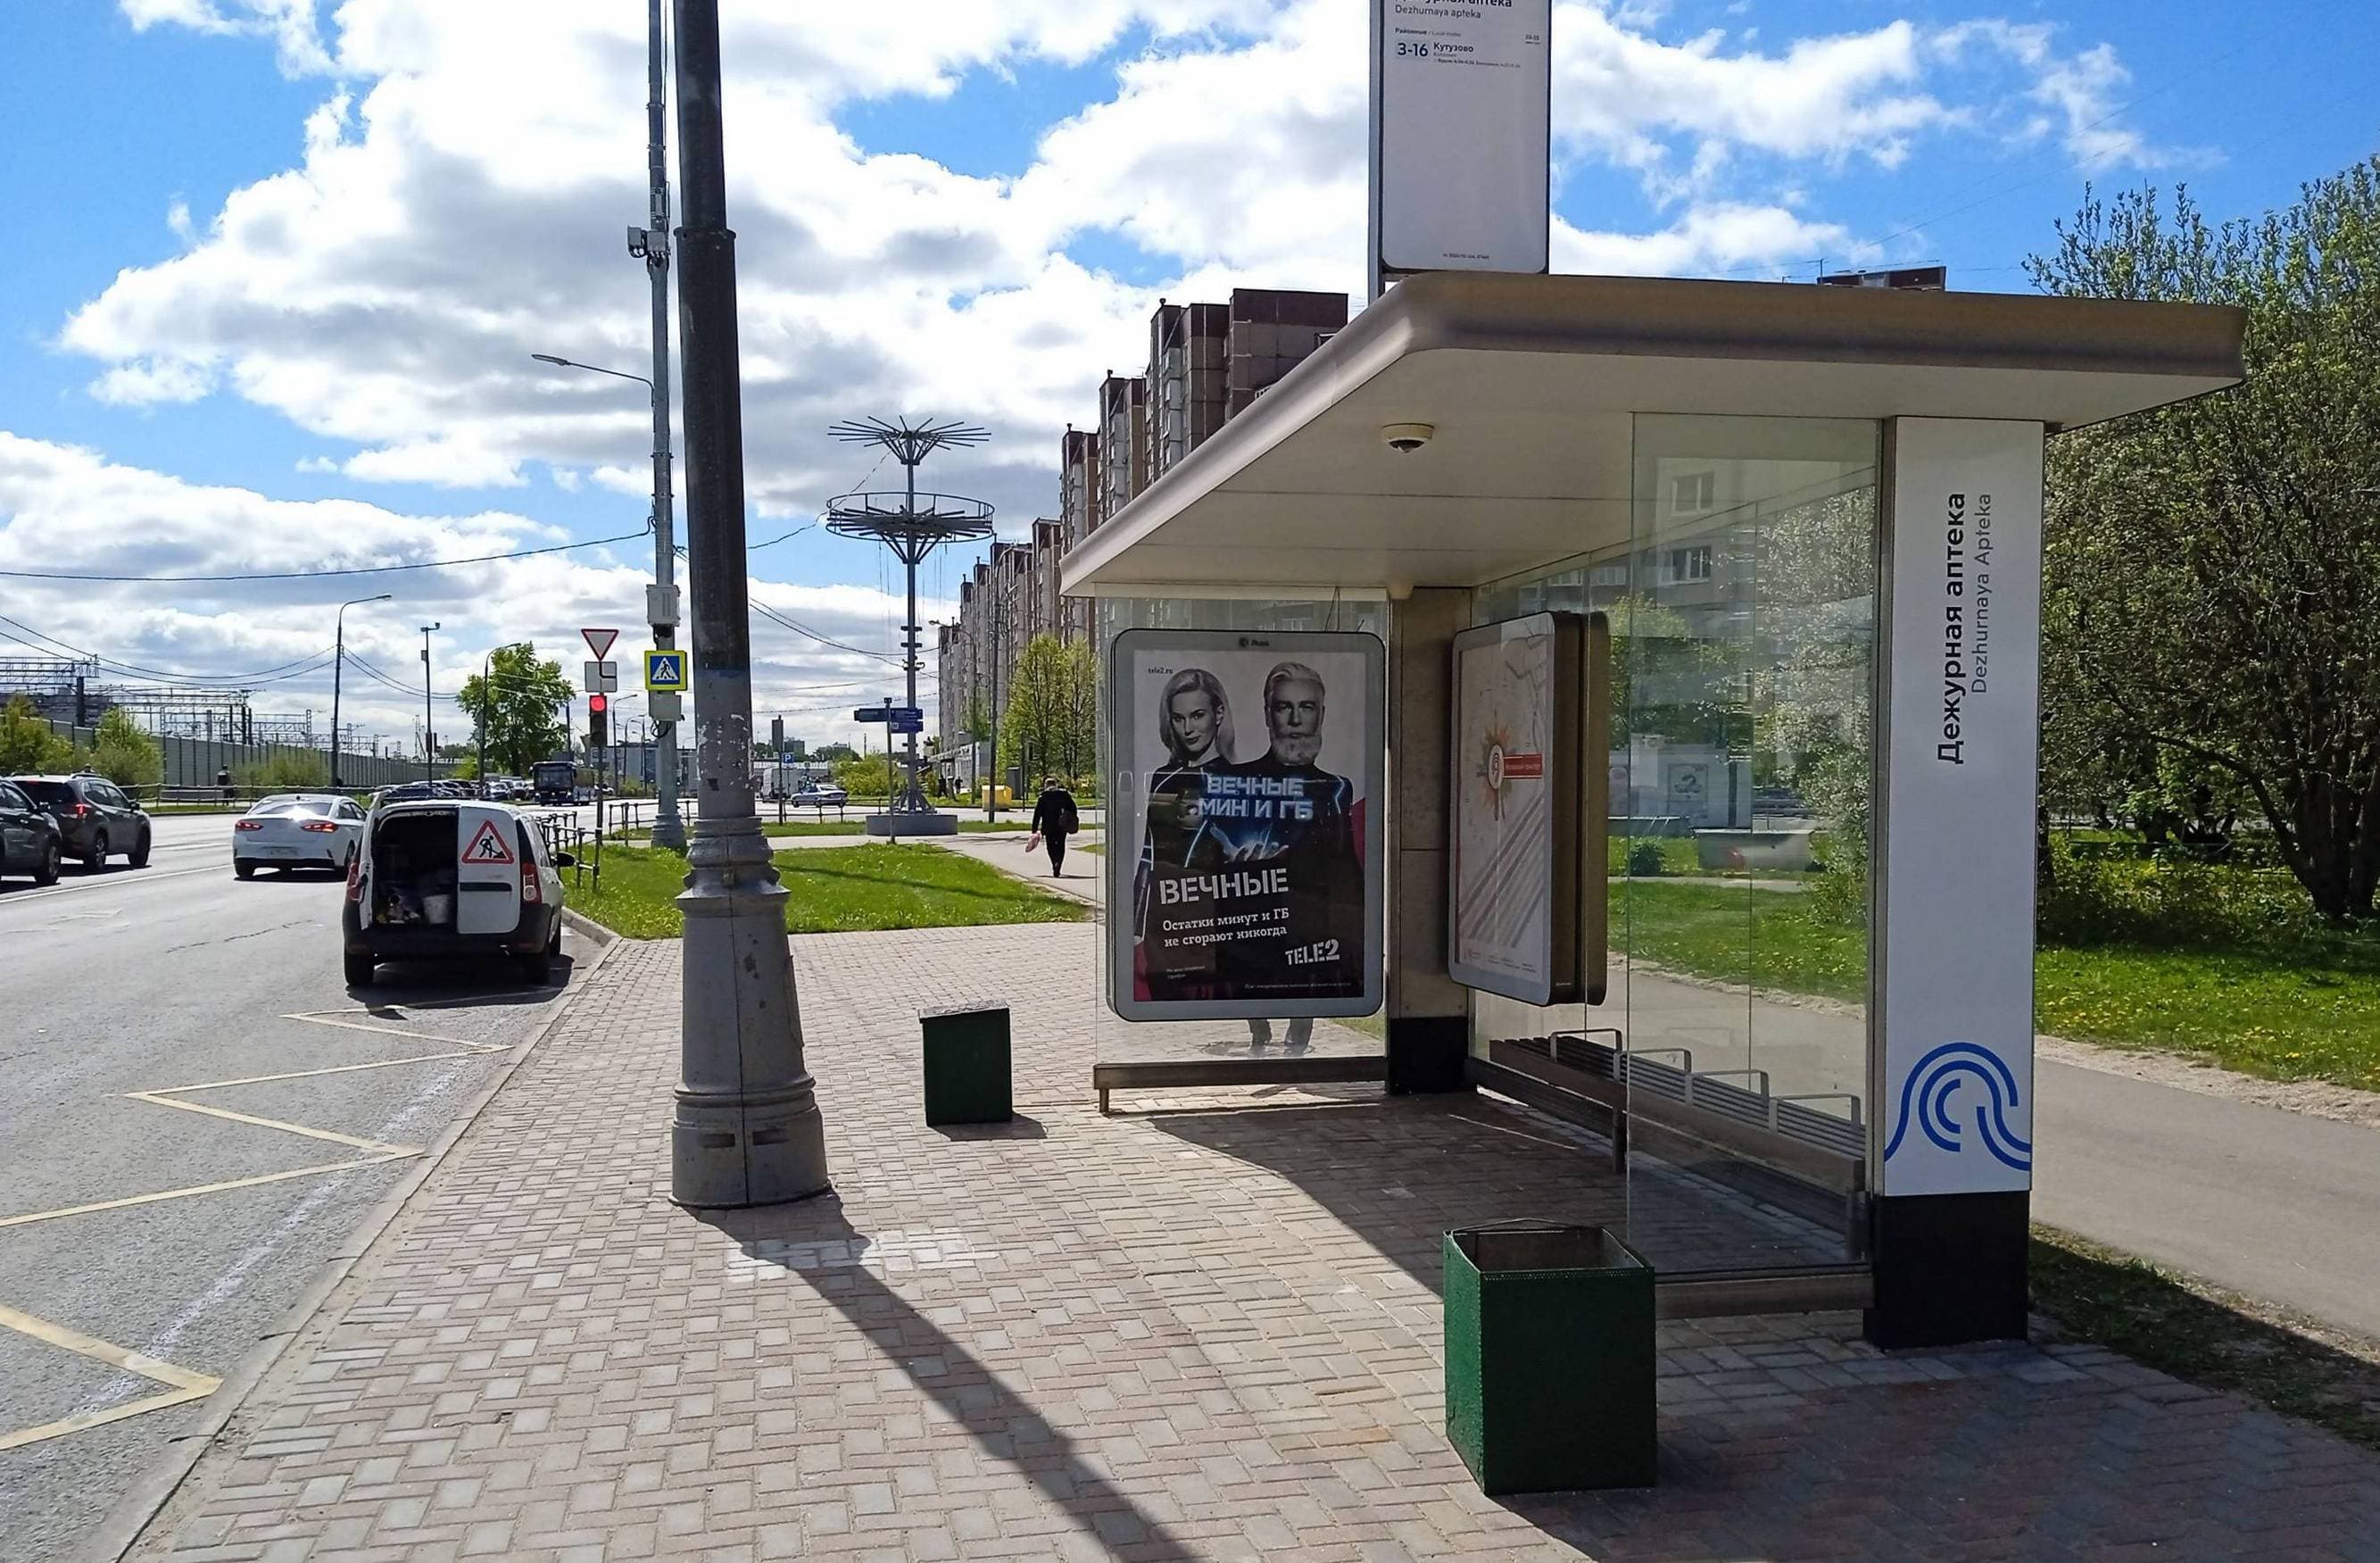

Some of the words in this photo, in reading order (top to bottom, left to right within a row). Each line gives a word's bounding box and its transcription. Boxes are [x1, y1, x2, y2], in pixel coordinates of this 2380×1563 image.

[1395, 4, 1449, 18] Dezhurnaya
[1450, 9, 1481, 19] apteka
[1433, 42, 1474, 53] Кутузово
[1974, 494, 1994, 565] Apteka
[1946, 493, 1965, 597] аптека
[1971, 573, 1992, 694] Dezhurnaya
[1937, 605, 1966, 765] Дежурная
[1207, 776, 1304, 796] ВЕЧНЫЕ
[1199, 797, 1249, 817] МИН
[1255, 799, 1272, 818] И
[1280, 800, 1314, 820] ГБ
[1160, 868, 1289, 905] ВЕЧНЫЕ
[1163, 917, 1215, 931] Остатки
[1217, 913, 1258, 926] минут
[1262, 912, 1270, 920] и
[1273, 907, 1290, 919] ГБ
[1165, 937, 1179, 947] не
[1182, 931, 1233, 945] сгорают
[1237, 926, 1287, 939] никогда
[1285, 938, 1339, 966] TELE2
